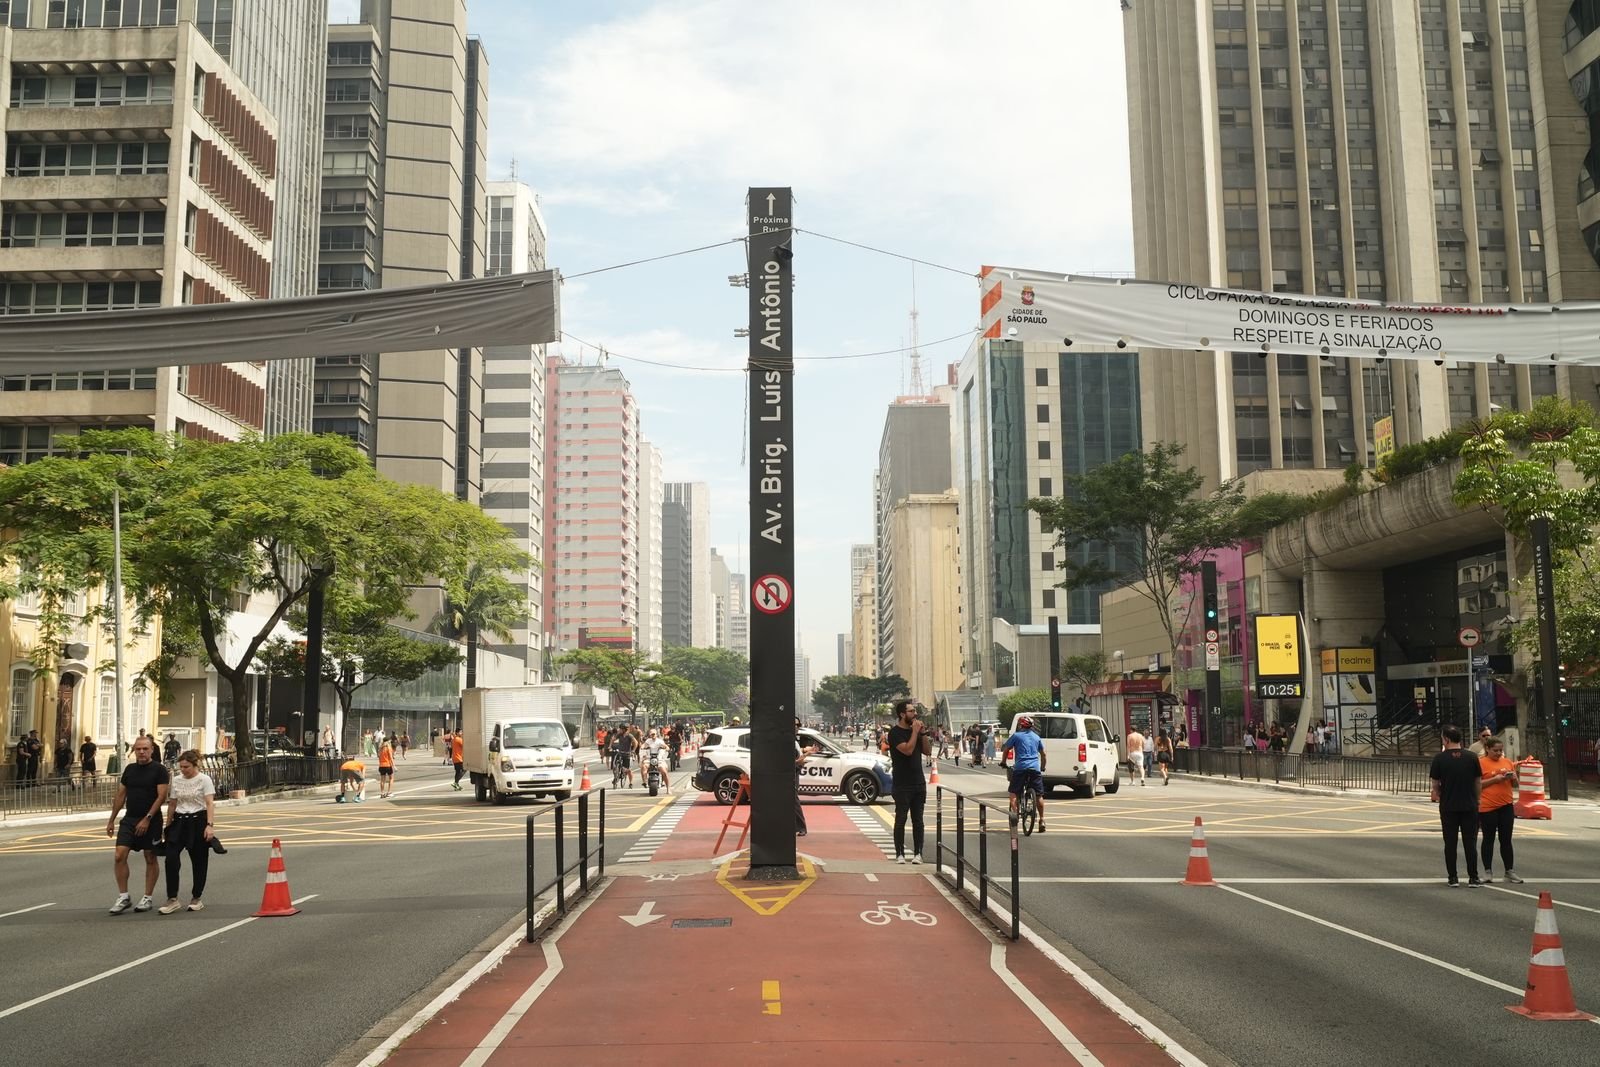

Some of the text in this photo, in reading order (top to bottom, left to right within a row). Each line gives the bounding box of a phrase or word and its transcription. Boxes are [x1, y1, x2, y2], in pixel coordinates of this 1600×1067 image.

[753, 216, 789, 224] Próxima
[1011, 308, 1034, 316] CIDADE
[1007, 314, 1048, 325] SÃO PAULO
[1239, 308, 1434, 332] DOMINGOS E FERIADOS
[1233, 327, 1442, 353] RESPEITE A SINALIZAÇÃO
[760, 260, 788, 544] Av. Brig. Luís Antônio
[1340, 656, 1372, 665] realme
[799, 766, 833, 777] GCM
